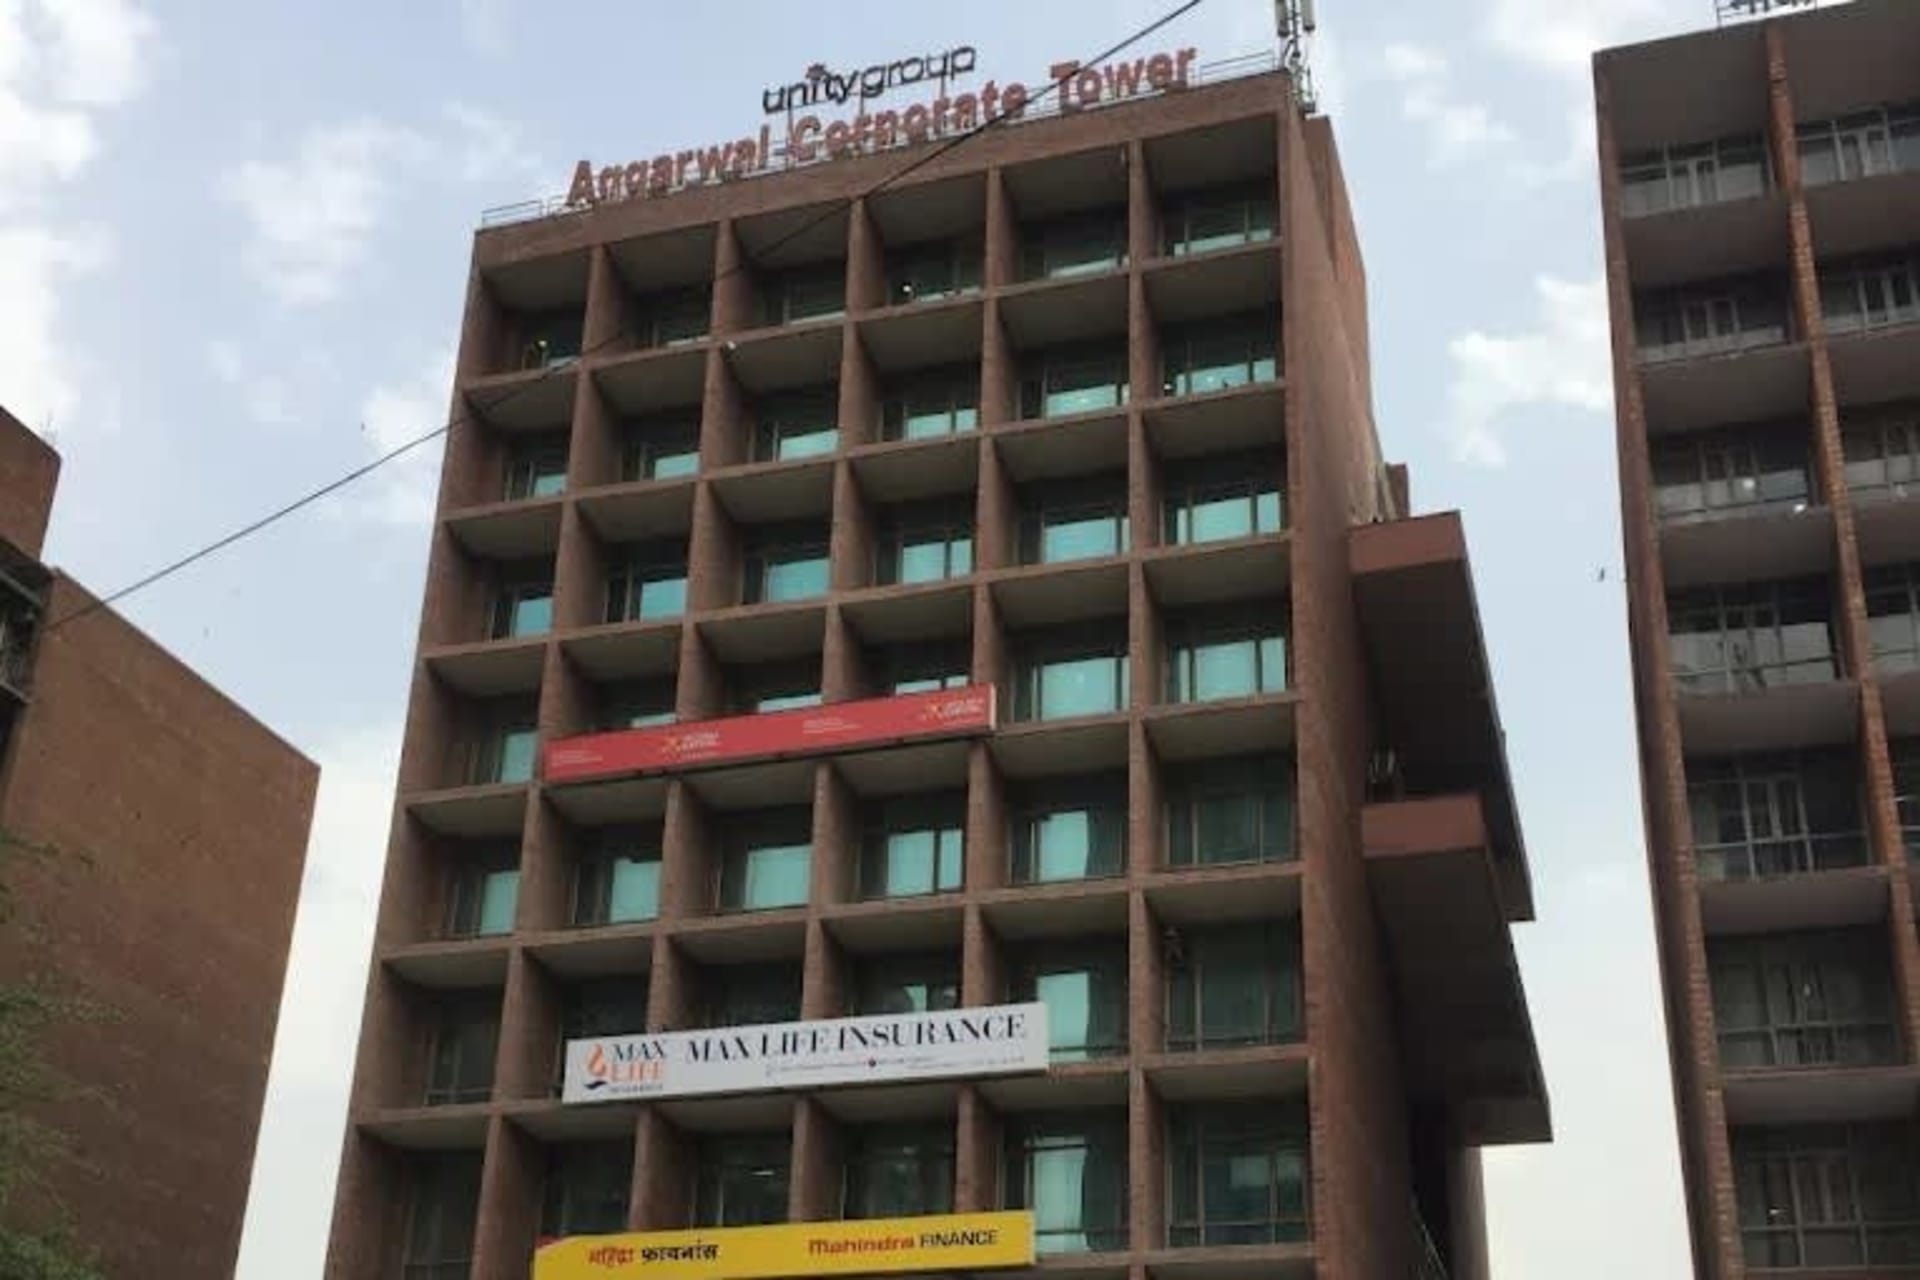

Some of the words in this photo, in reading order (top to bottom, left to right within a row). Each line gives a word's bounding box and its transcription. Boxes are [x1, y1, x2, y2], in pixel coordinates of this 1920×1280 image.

[566, 124, 770, 206] Aggarwal
[788, 82, 1028, 161] Corporate
[1051, 47, 1197, 112] Tower
[613, 1040, 666, 1061] MAX
[686, 1036, 750, 1062] MAX
[759, 1027, 831, 1057] LIFE
[838, 1012, 1026, 1051] INSURANCE
[918, 1228, 999, 1248] FINANCE
